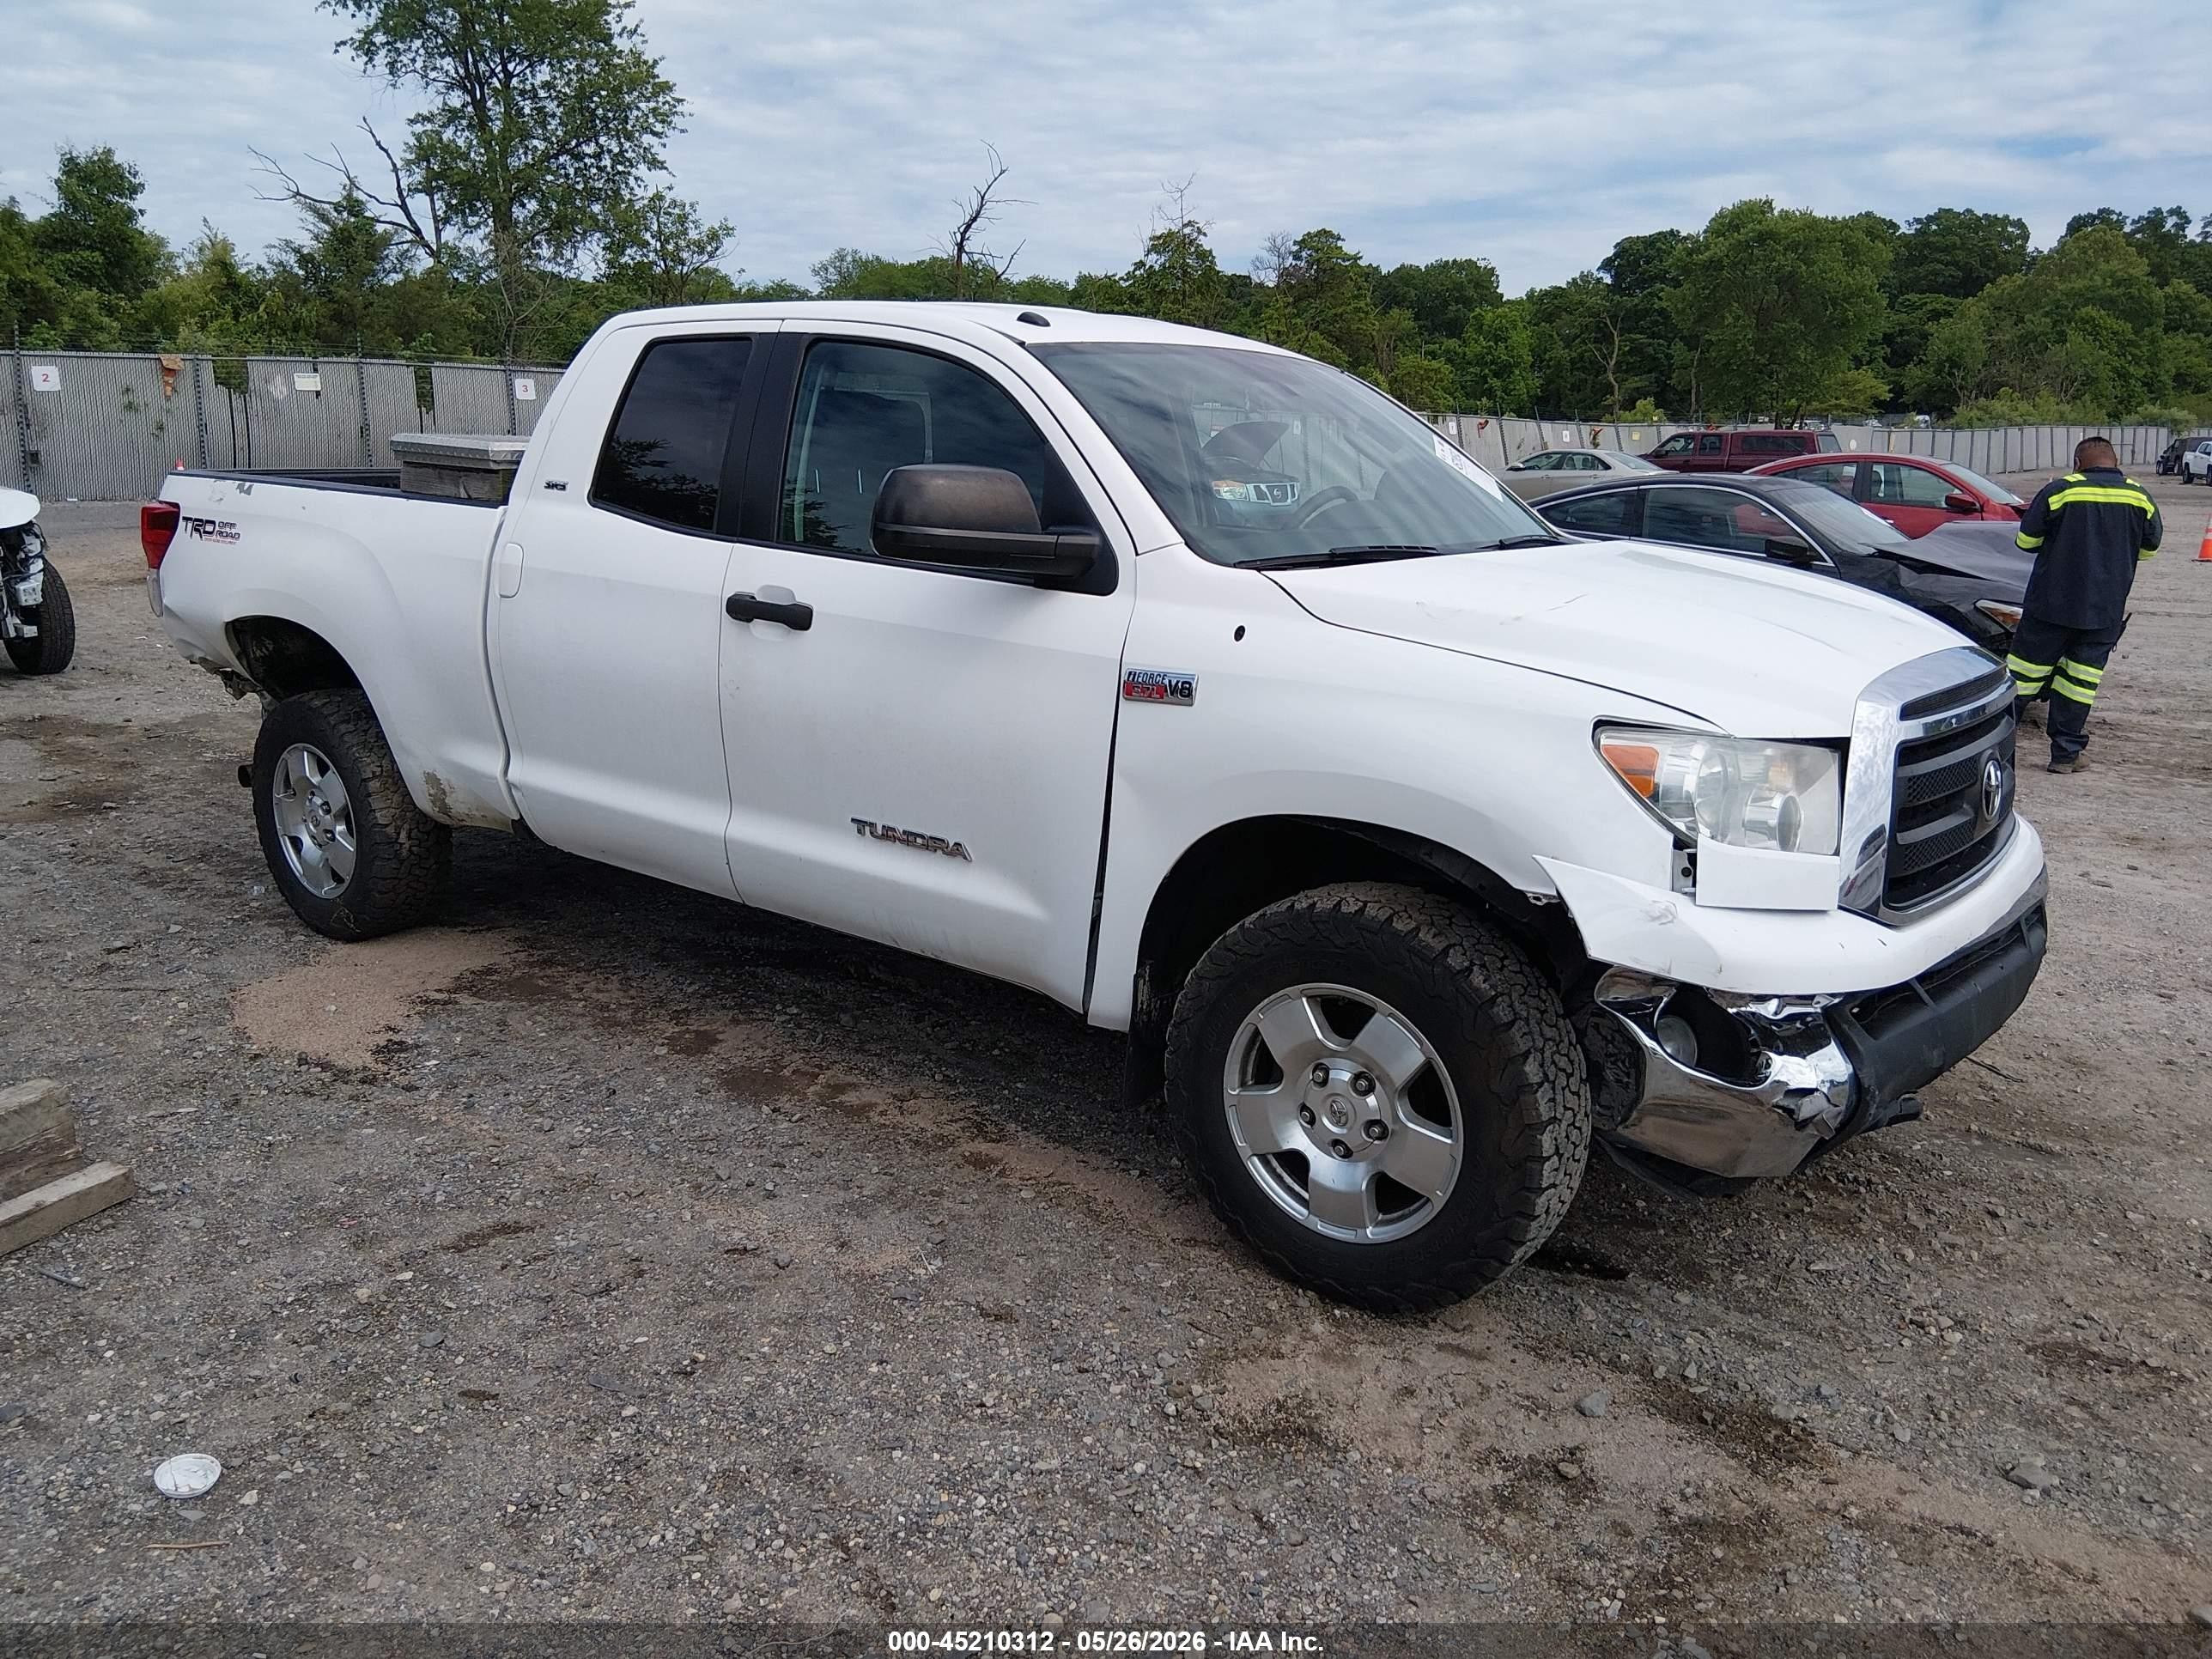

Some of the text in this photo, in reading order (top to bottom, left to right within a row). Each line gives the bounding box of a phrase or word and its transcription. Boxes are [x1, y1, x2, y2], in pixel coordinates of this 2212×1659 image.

[41, 373, 51, 383] 2
[521, 384, 529, 392] 3
[182, 516, 216, 541] TRD
[217, 520, 237, 531] OFF
[216, 529, 241, 540] ROAD
[1132, 684, 1161, 698] 5.7L
[1167, 678, 1194, 700] V8
[850, 816, 973, 862] TUNDRA
